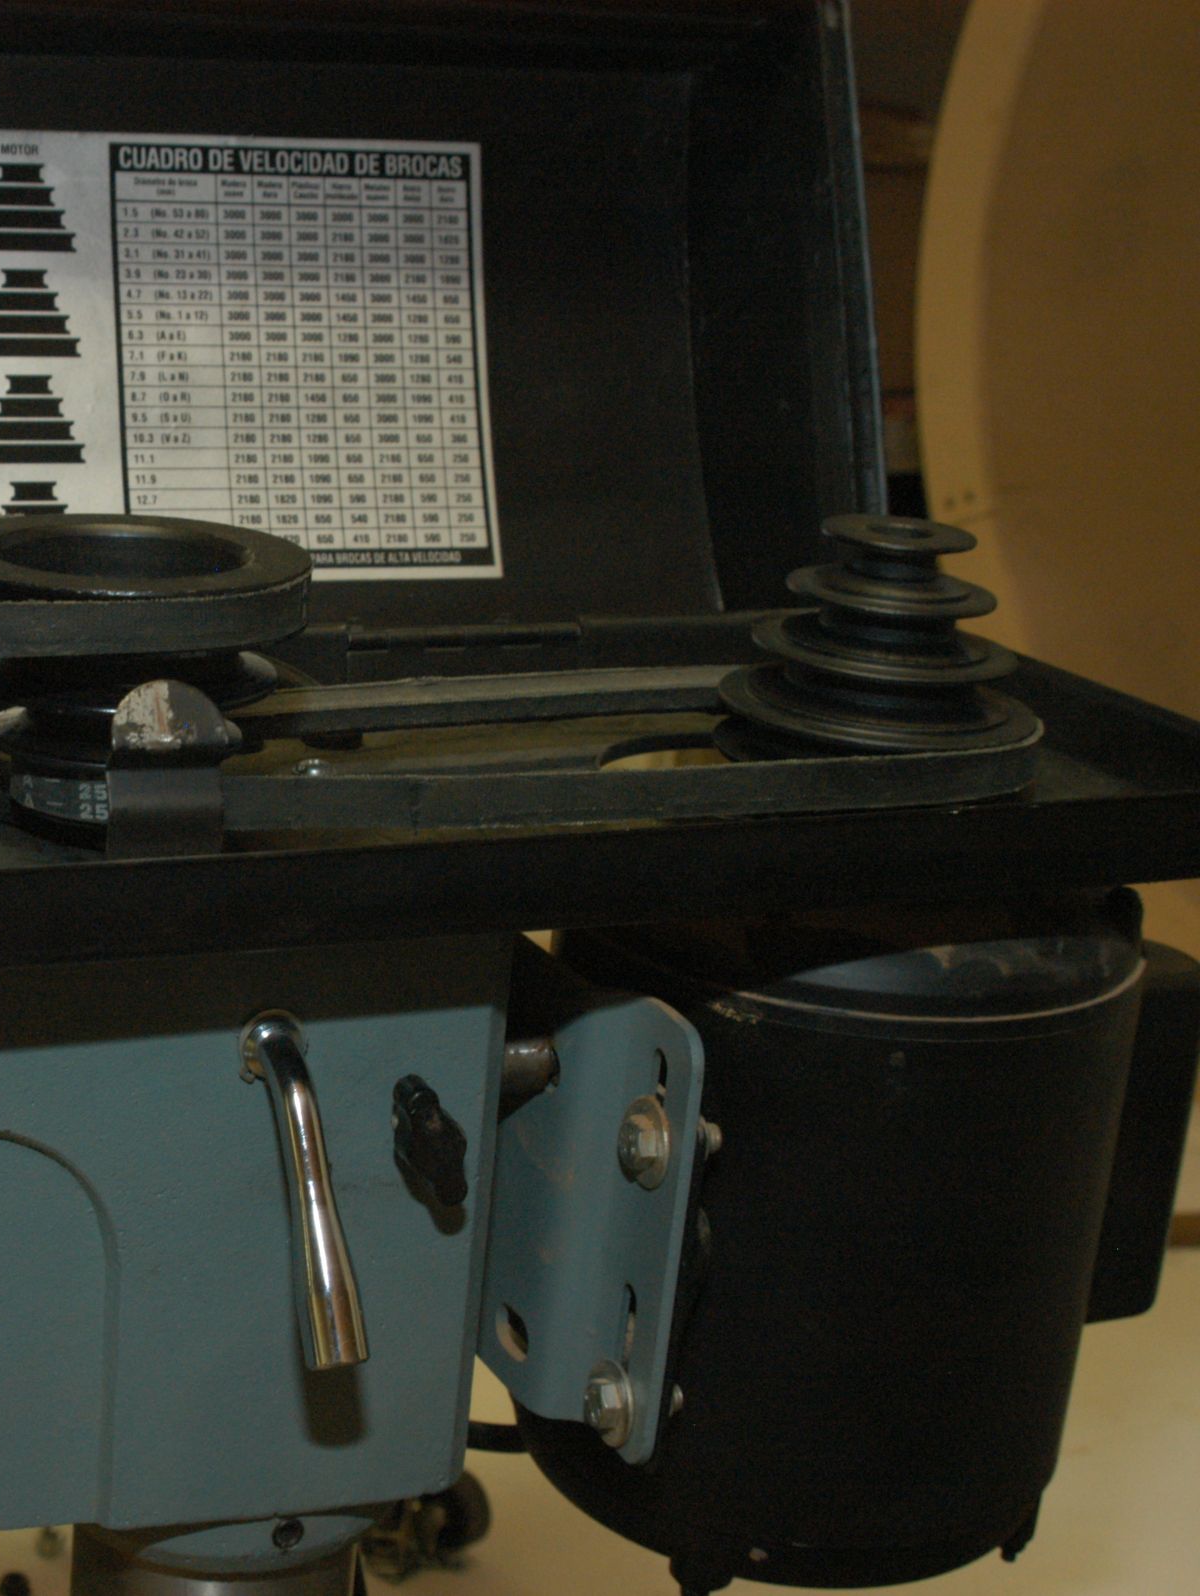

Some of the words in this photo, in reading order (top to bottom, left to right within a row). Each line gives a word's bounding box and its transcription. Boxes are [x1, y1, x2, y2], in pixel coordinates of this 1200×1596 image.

[0, 143, 39, 155] MOTOR
[118, 146, 203, 170] CUADRO
[208, 148, 235, 171] DE
[239, 149, 349, 175] VELOCIDAD
[354, 153, 381, 176] DE
[384, 154, 463, 178] BROCAS
[134, 454, 154, 464] 11.1
[135, 474, 157, 484] 11.9
[136, 495, 157, 505] 12.7
[78, 783, 108, 800] 25
[79, 803, 109, 820] 25
